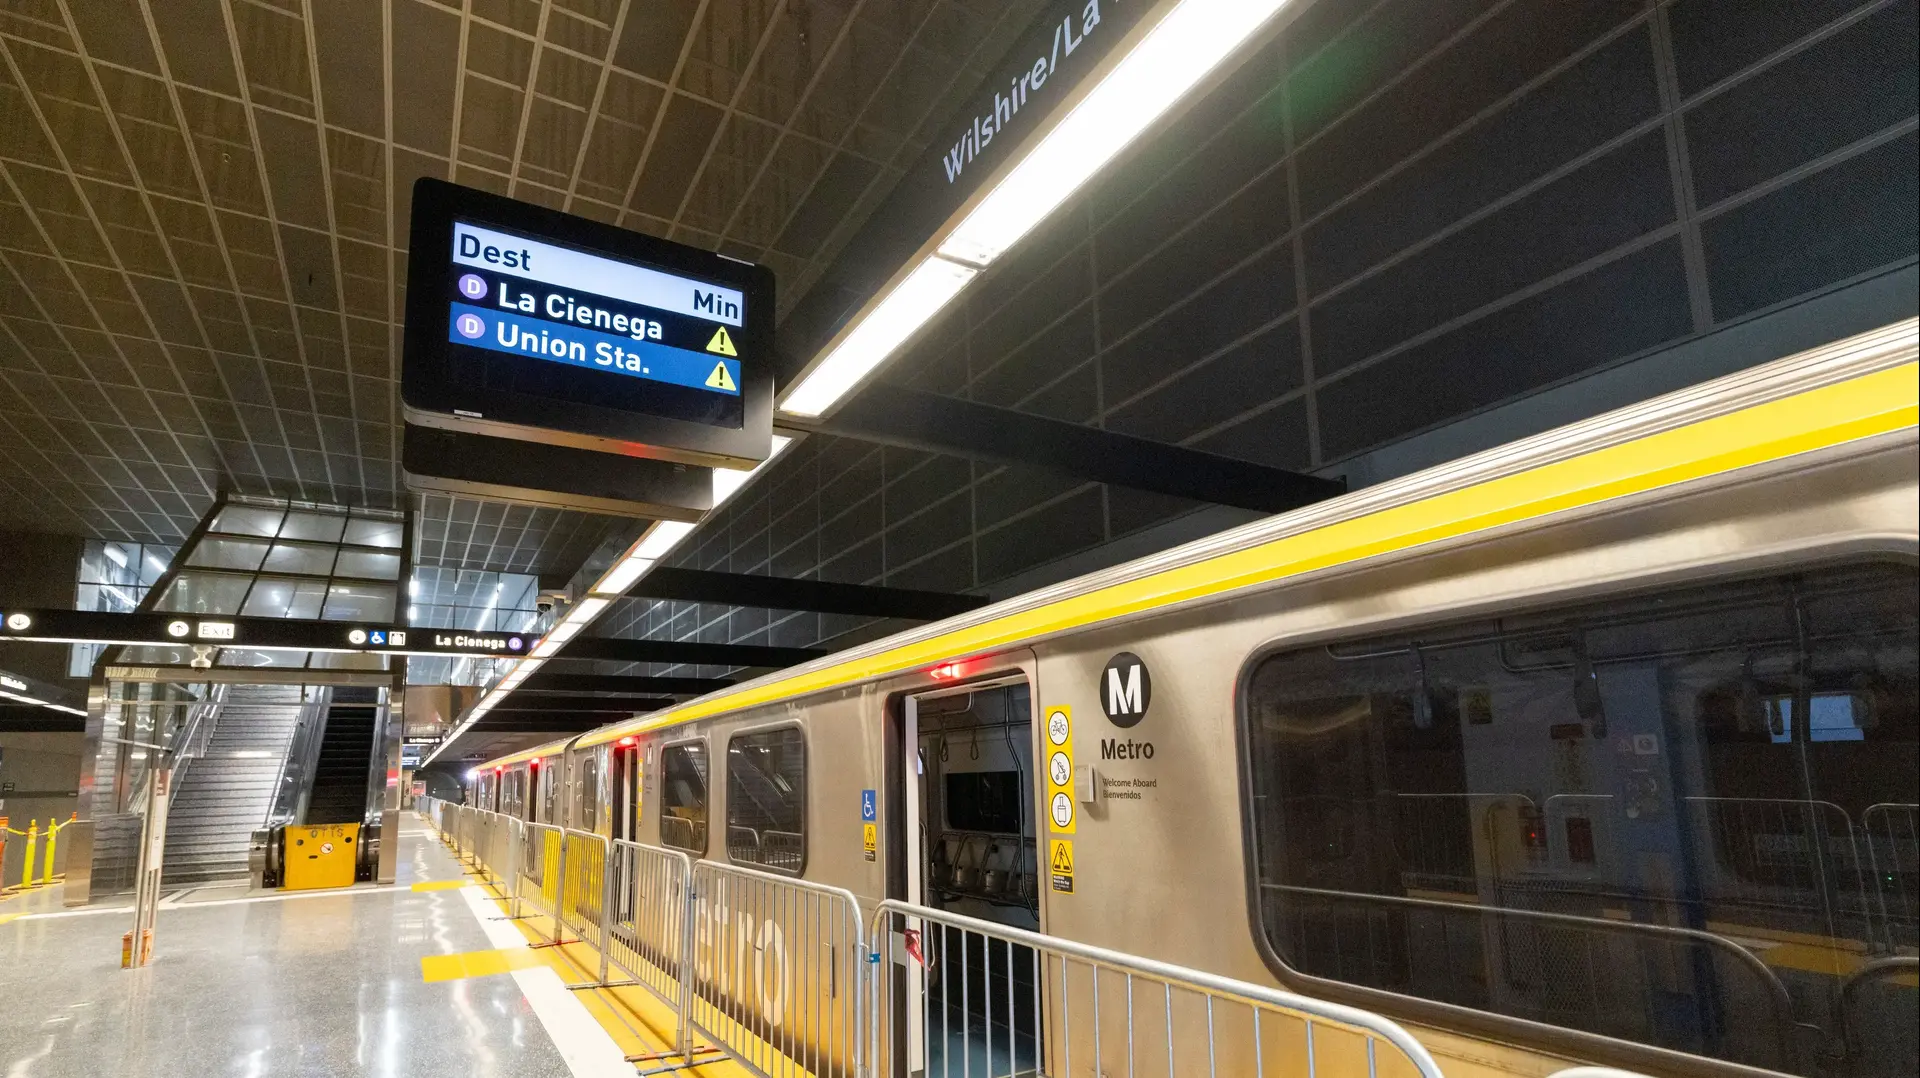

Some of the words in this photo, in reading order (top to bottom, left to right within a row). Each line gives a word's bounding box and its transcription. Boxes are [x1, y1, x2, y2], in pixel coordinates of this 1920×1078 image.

[459, 233, 530, 272] Dest
[499, 283, 535, 313] La
[545, 290, 662, 341] Cienega
[693, 289, 738, 320] Min
[497, 322, 585, 361] Union
[594, 344, 650, 374] Sta.
[202, 625, 231, 637] Exit
[435, 635, 452, 647] La
[454, 635, 506, 650] Cienega
[1108, 664, 1142, 715] M
[1101, 738, 1154, 760] Metro
[1102, 778, 1132, 788] Welcome
[1132, 779, 1157, 788] Aboard
[1102, 790, 1142, 800] Bienvenidos
[311, 828, 344, 838] OTIS
